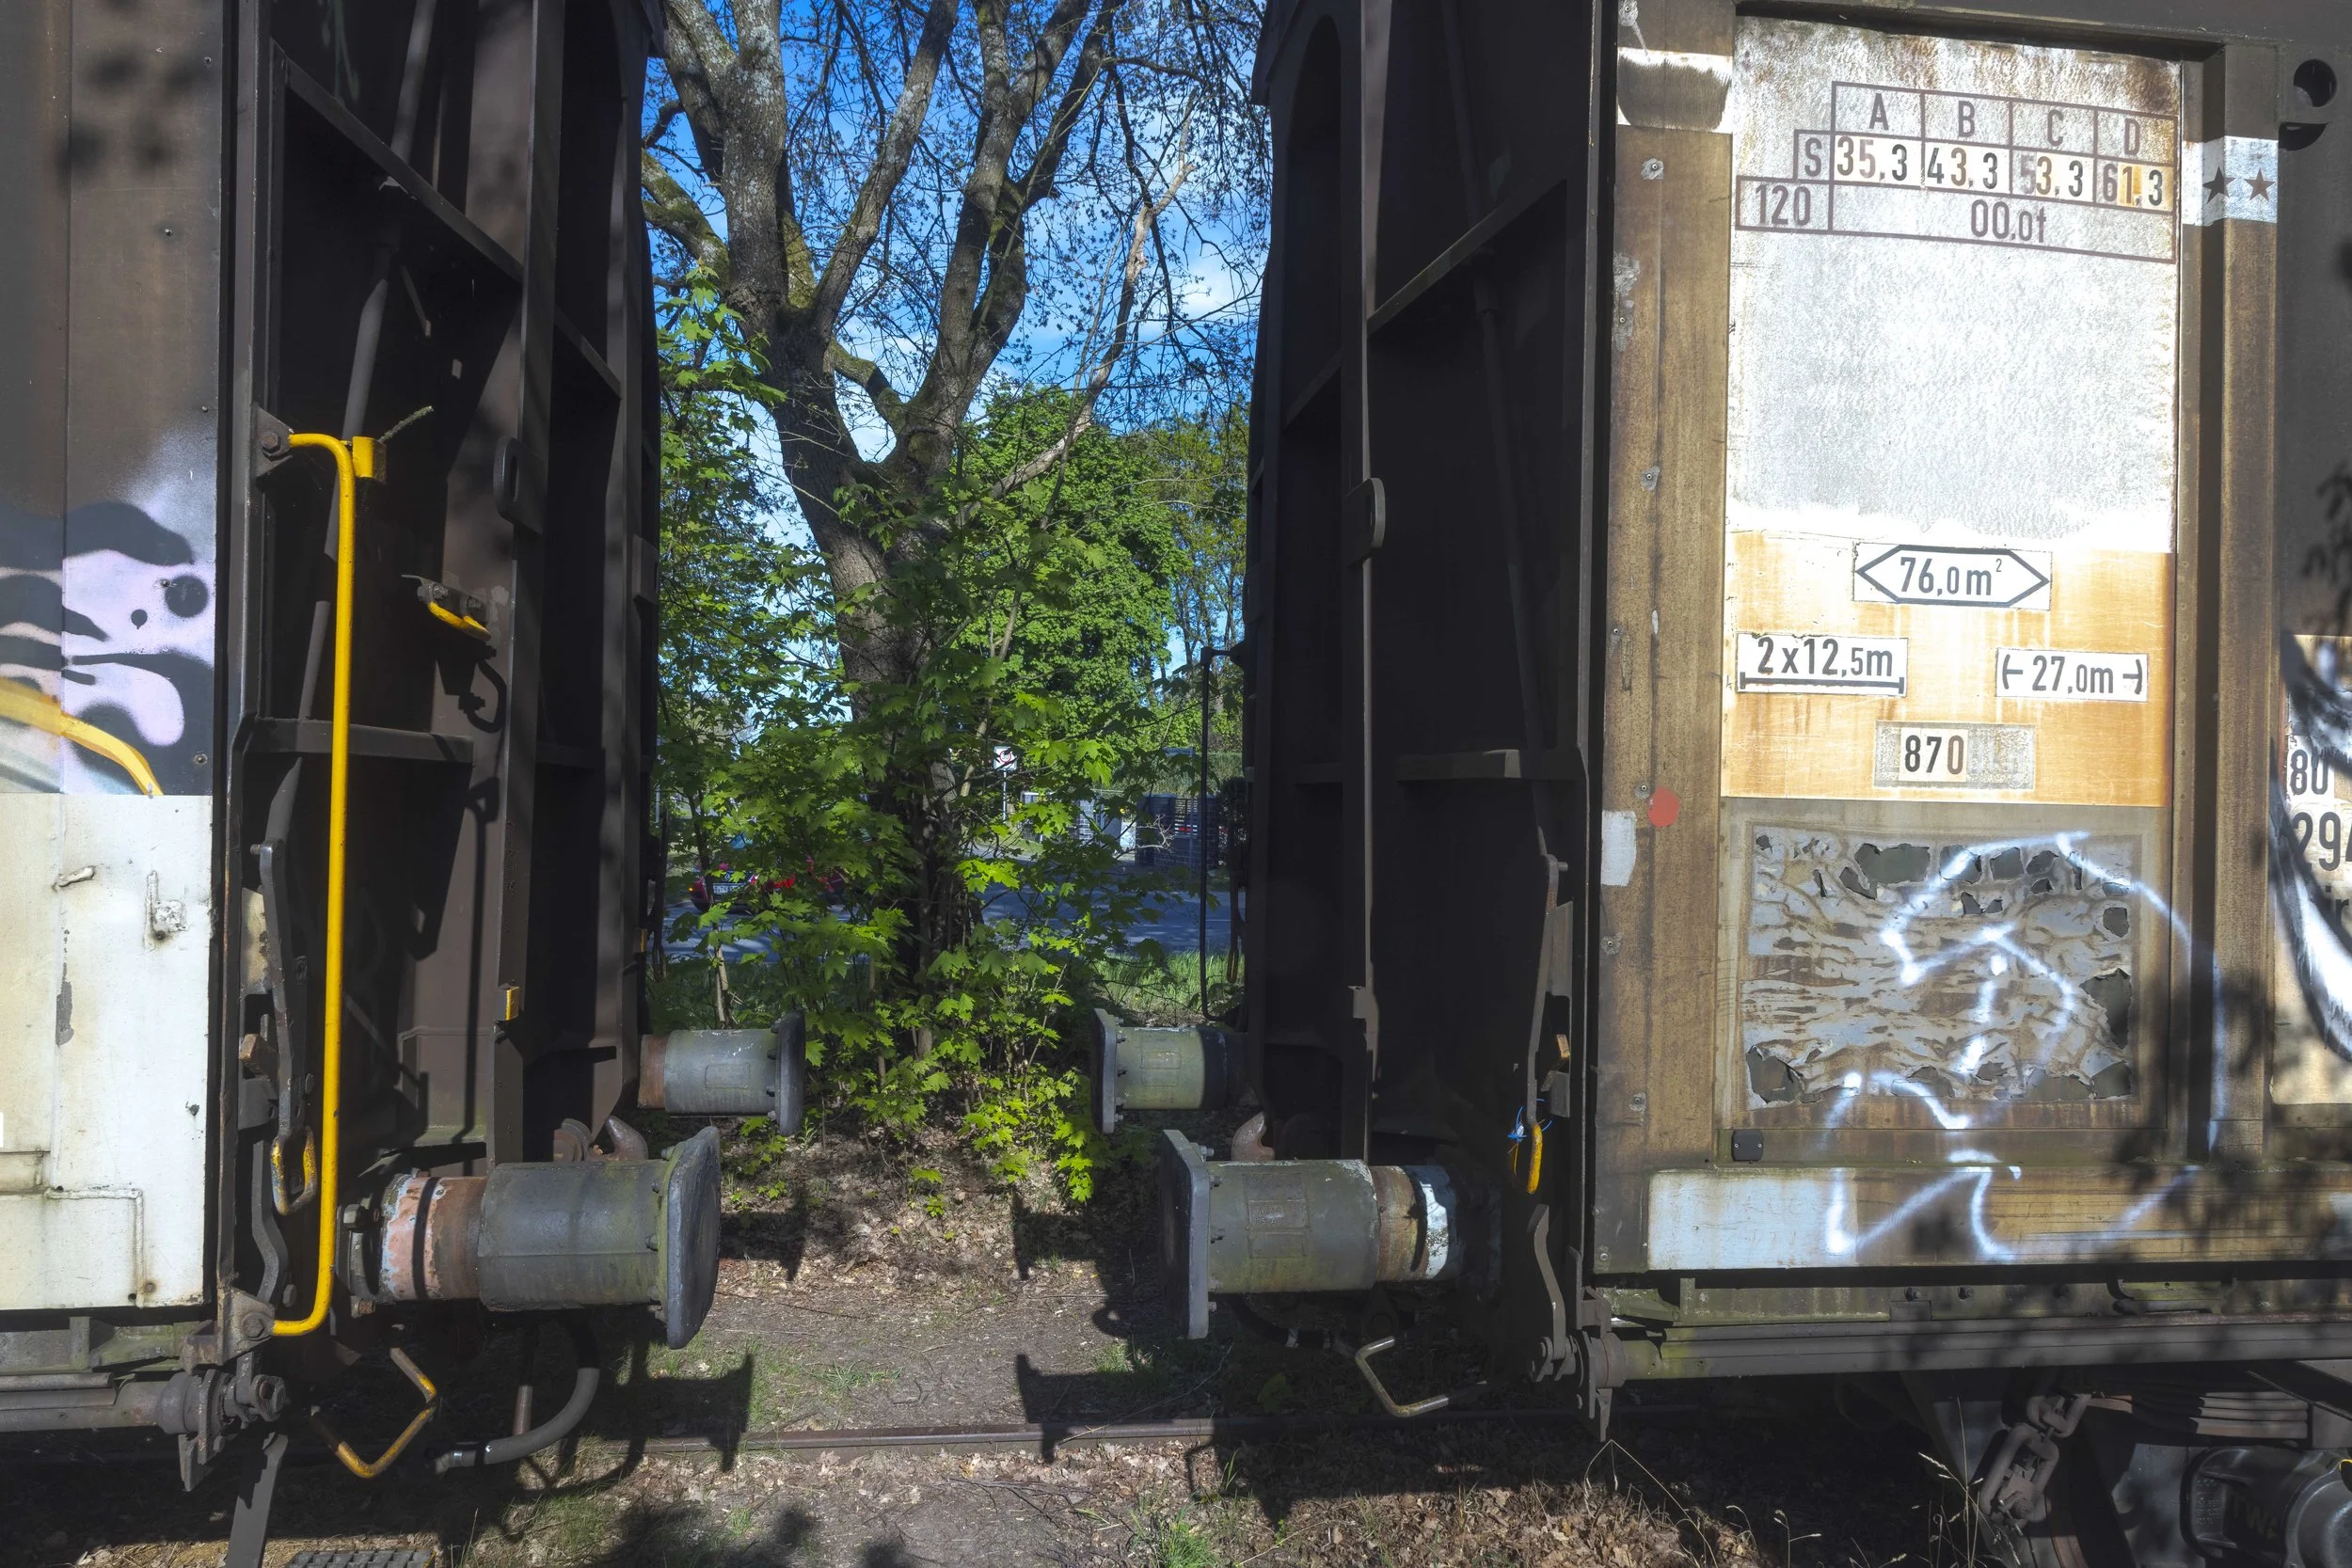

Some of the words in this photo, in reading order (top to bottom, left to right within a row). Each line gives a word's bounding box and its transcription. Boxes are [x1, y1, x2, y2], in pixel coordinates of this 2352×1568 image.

[1869, 93, 1889, 131] A
[1958, 100, 1976, 138] B
[2047, 109, 2064, 147] C
[2123, 118, 2141, 156] D
[1804, 137, 1822, 177] S
[1756, 183, 1811, 226] 120
[1904, 735, 1964, 774] 870
[2290, 749, 2328, 795] 80
